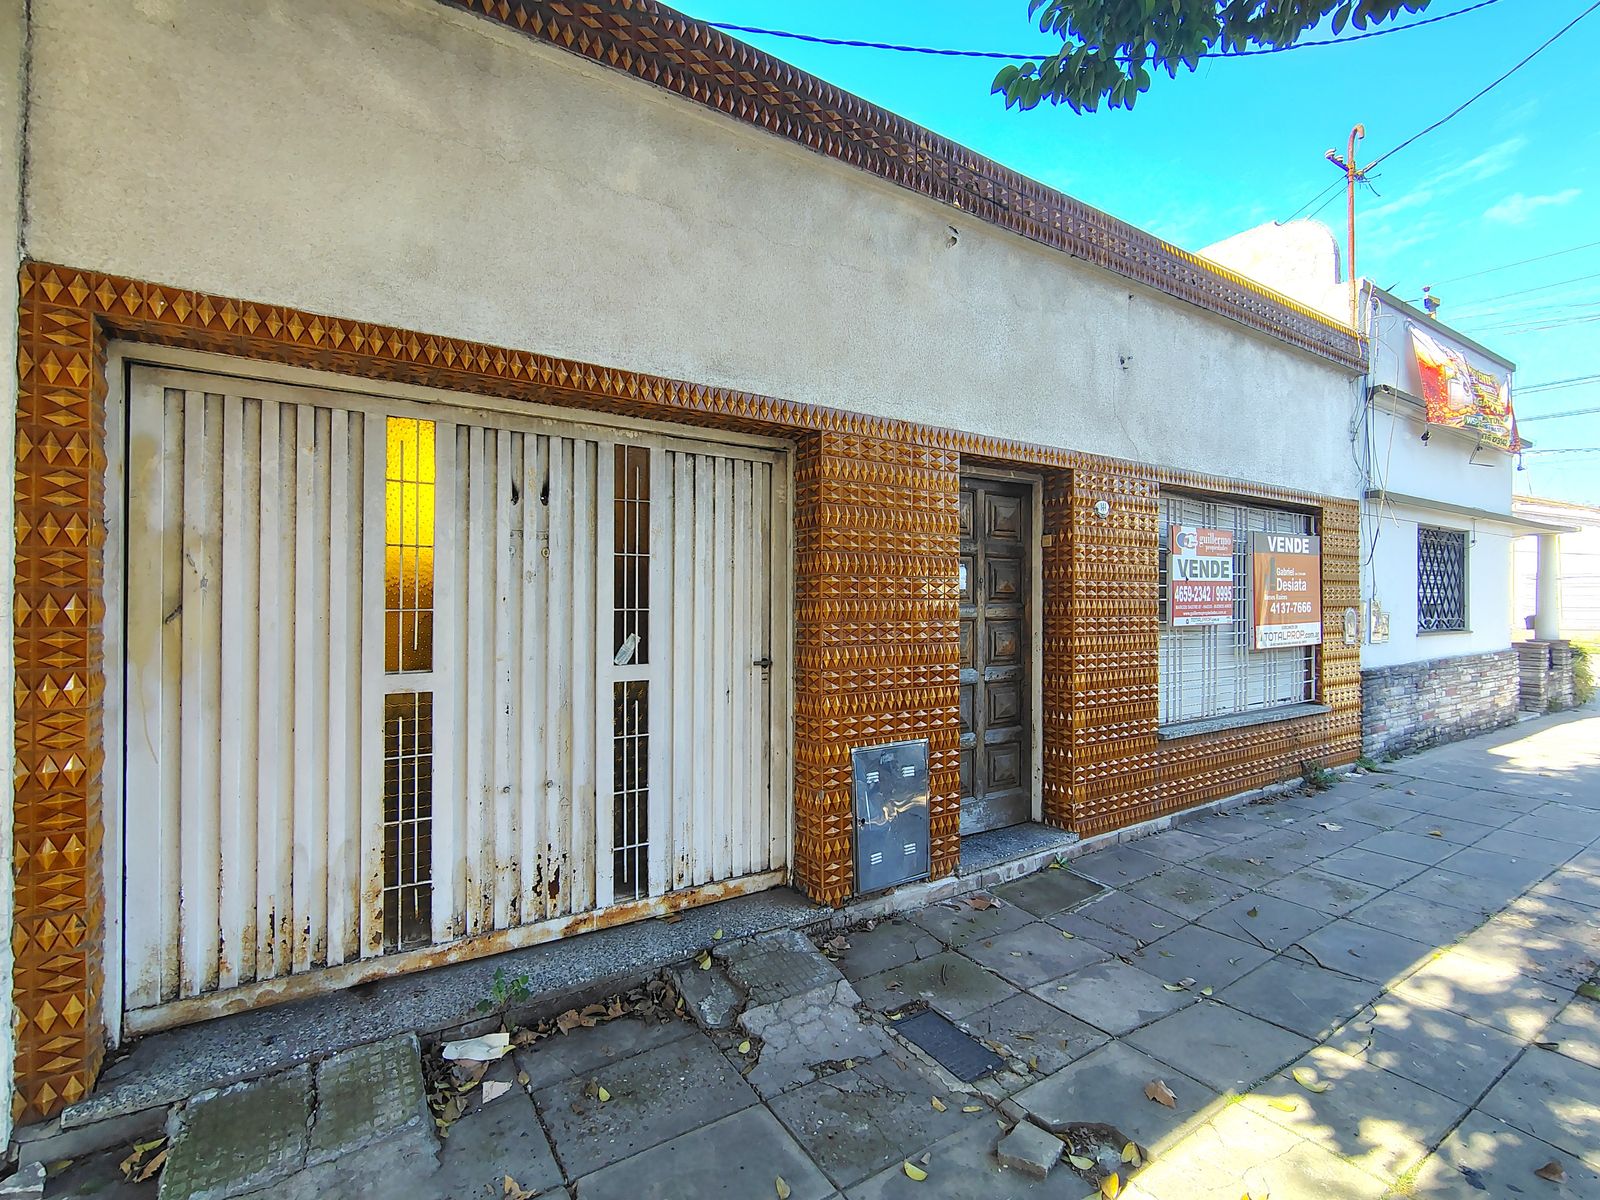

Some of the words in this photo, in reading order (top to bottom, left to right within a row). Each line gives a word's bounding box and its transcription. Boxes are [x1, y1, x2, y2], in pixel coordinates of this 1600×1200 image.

[1199, 533, 1231, 547] guillermo
[1267, 536, 1309, 554] VENDE
[1177, 559, 1230, 578] VENDE
[1276, 568, 1295, 576] Gabriel
[1276, 578, 1307, 591] Desiata
[1175, 585, 1211, 603] 4659-2342
[1270, 602, 1312, 614] 4137-7666
